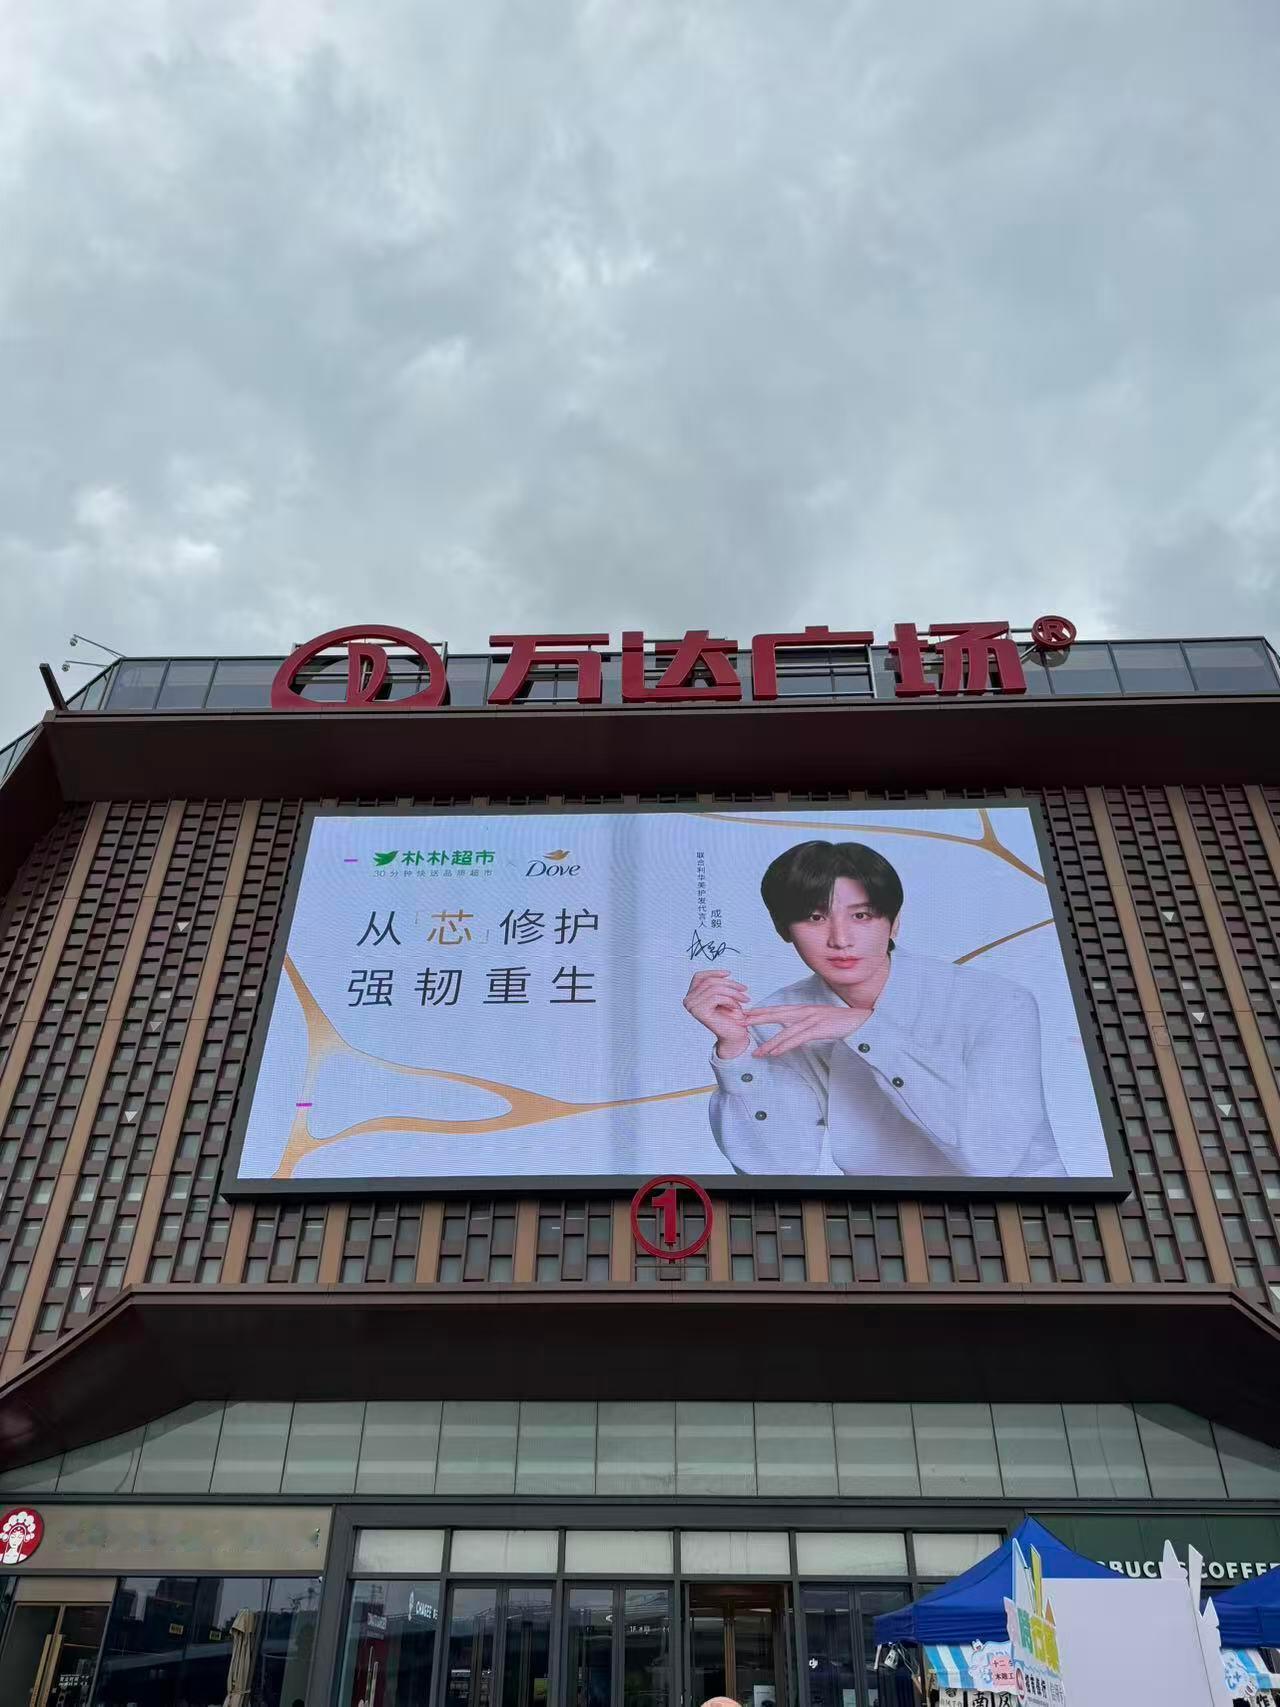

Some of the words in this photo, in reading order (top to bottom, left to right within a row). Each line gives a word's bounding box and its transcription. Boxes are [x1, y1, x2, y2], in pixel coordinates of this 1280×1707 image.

[488, 621, 1027, 705] 万达广场
[402, 850, 496, 866] 朴朴超市
[525, 859, 581, 877] Dove
[347, 966, 597, 1007] 强韧重生
